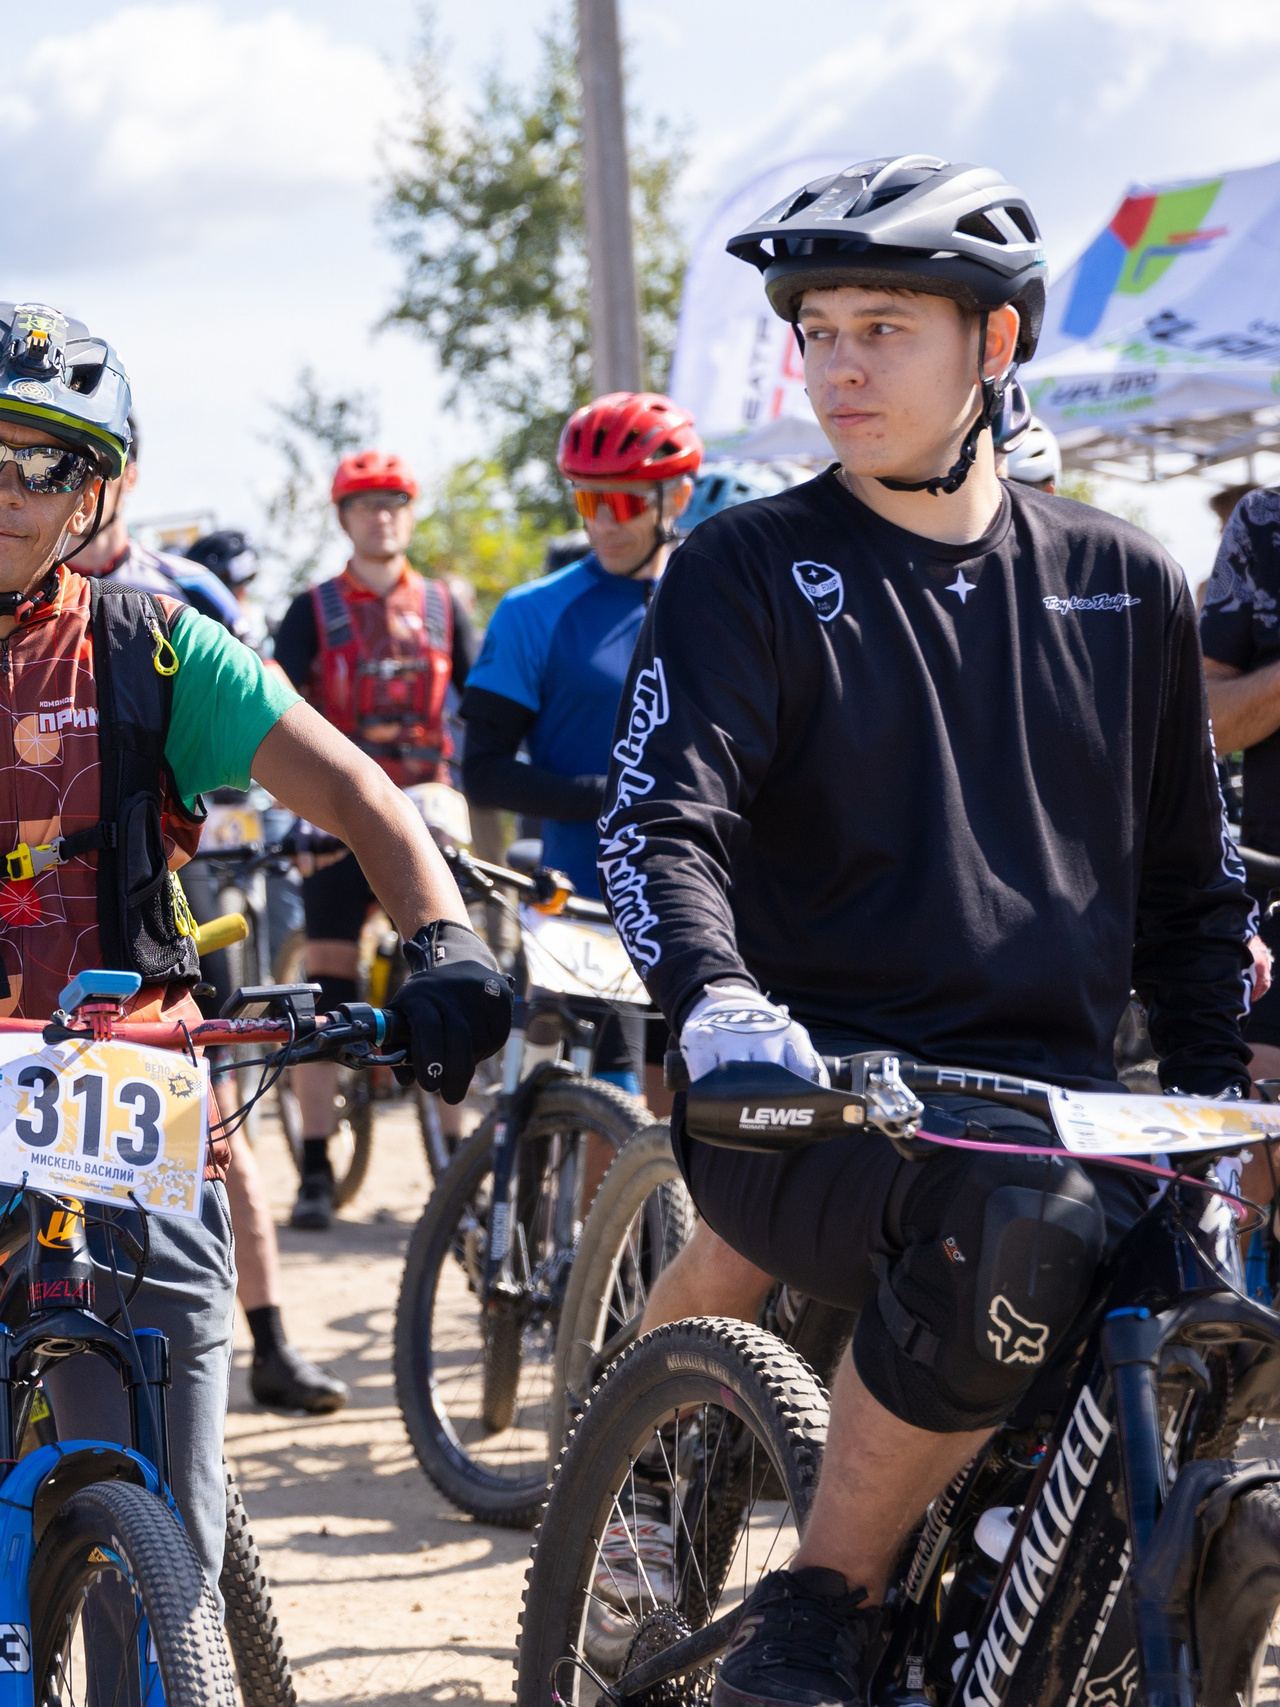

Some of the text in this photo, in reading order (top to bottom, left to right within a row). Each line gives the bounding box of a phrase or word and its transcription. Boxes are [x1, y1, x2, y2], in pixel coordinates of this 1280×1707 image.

[39, 696, 75, 708] КОМАНДА
[145, 1062, 171, 1076] ВЕЛО
[15, 1065, 161, 1167] 313
[739, 1106, 816, 1127] LEWIS
[30, 1152, 135, 1183] МИСКЕЛЬ ВАСИЛИЙ
[962, 1384, 1112, 1707] SPECIALIZED
